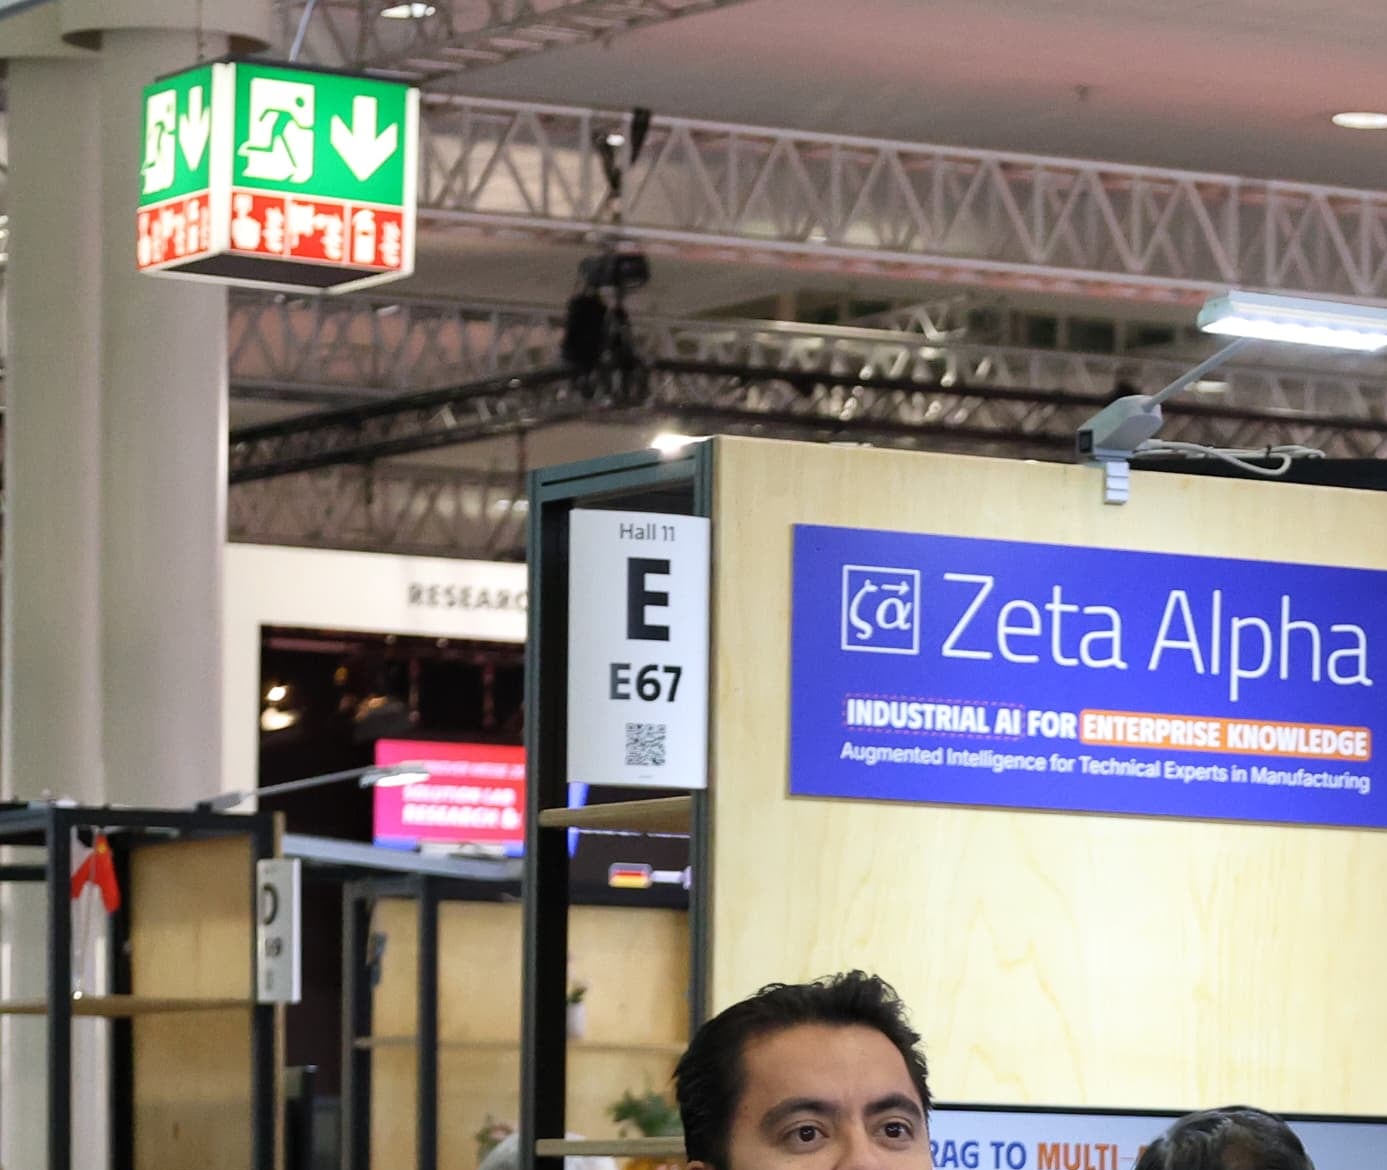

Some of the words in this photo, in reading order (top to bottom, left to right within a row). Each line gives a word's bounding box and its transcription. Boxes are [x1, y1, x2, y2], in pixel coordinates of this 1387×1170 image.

[619, 523, 656, 541] Hall
[662, 525, 675, 541] 11
[408, 582, 529, 613] RESEARC
[626, 557, 670, 641] E
[942, 572, 1128, 670] Zeta
[1149, 589, 1373, 702] Alpha
[610, 662, 682, 702] E67
[847, 699, 990, 733] INDUSTRIAL
[994, 708, 1021, 736] AI
[1027, 711, 1077, 739] FOR
[1083, 714, 1221, 747] ENTERPRISE
[1227, 723, 1367, 757] KNOWLEDGE
[840, 742, 943, 765] Augmented
[946, 748, 1046, 773] Intelligence
[1049, 754, 1076, 772] for
[1080, 756, 1160, 778] Technical
[1164, 760, 1228, 784] Experts
[1231, 765, 1247, 782] in
[1251, 766, 1370, 794] Manufacturing
[990, 1141, 1027, 1170] TO
